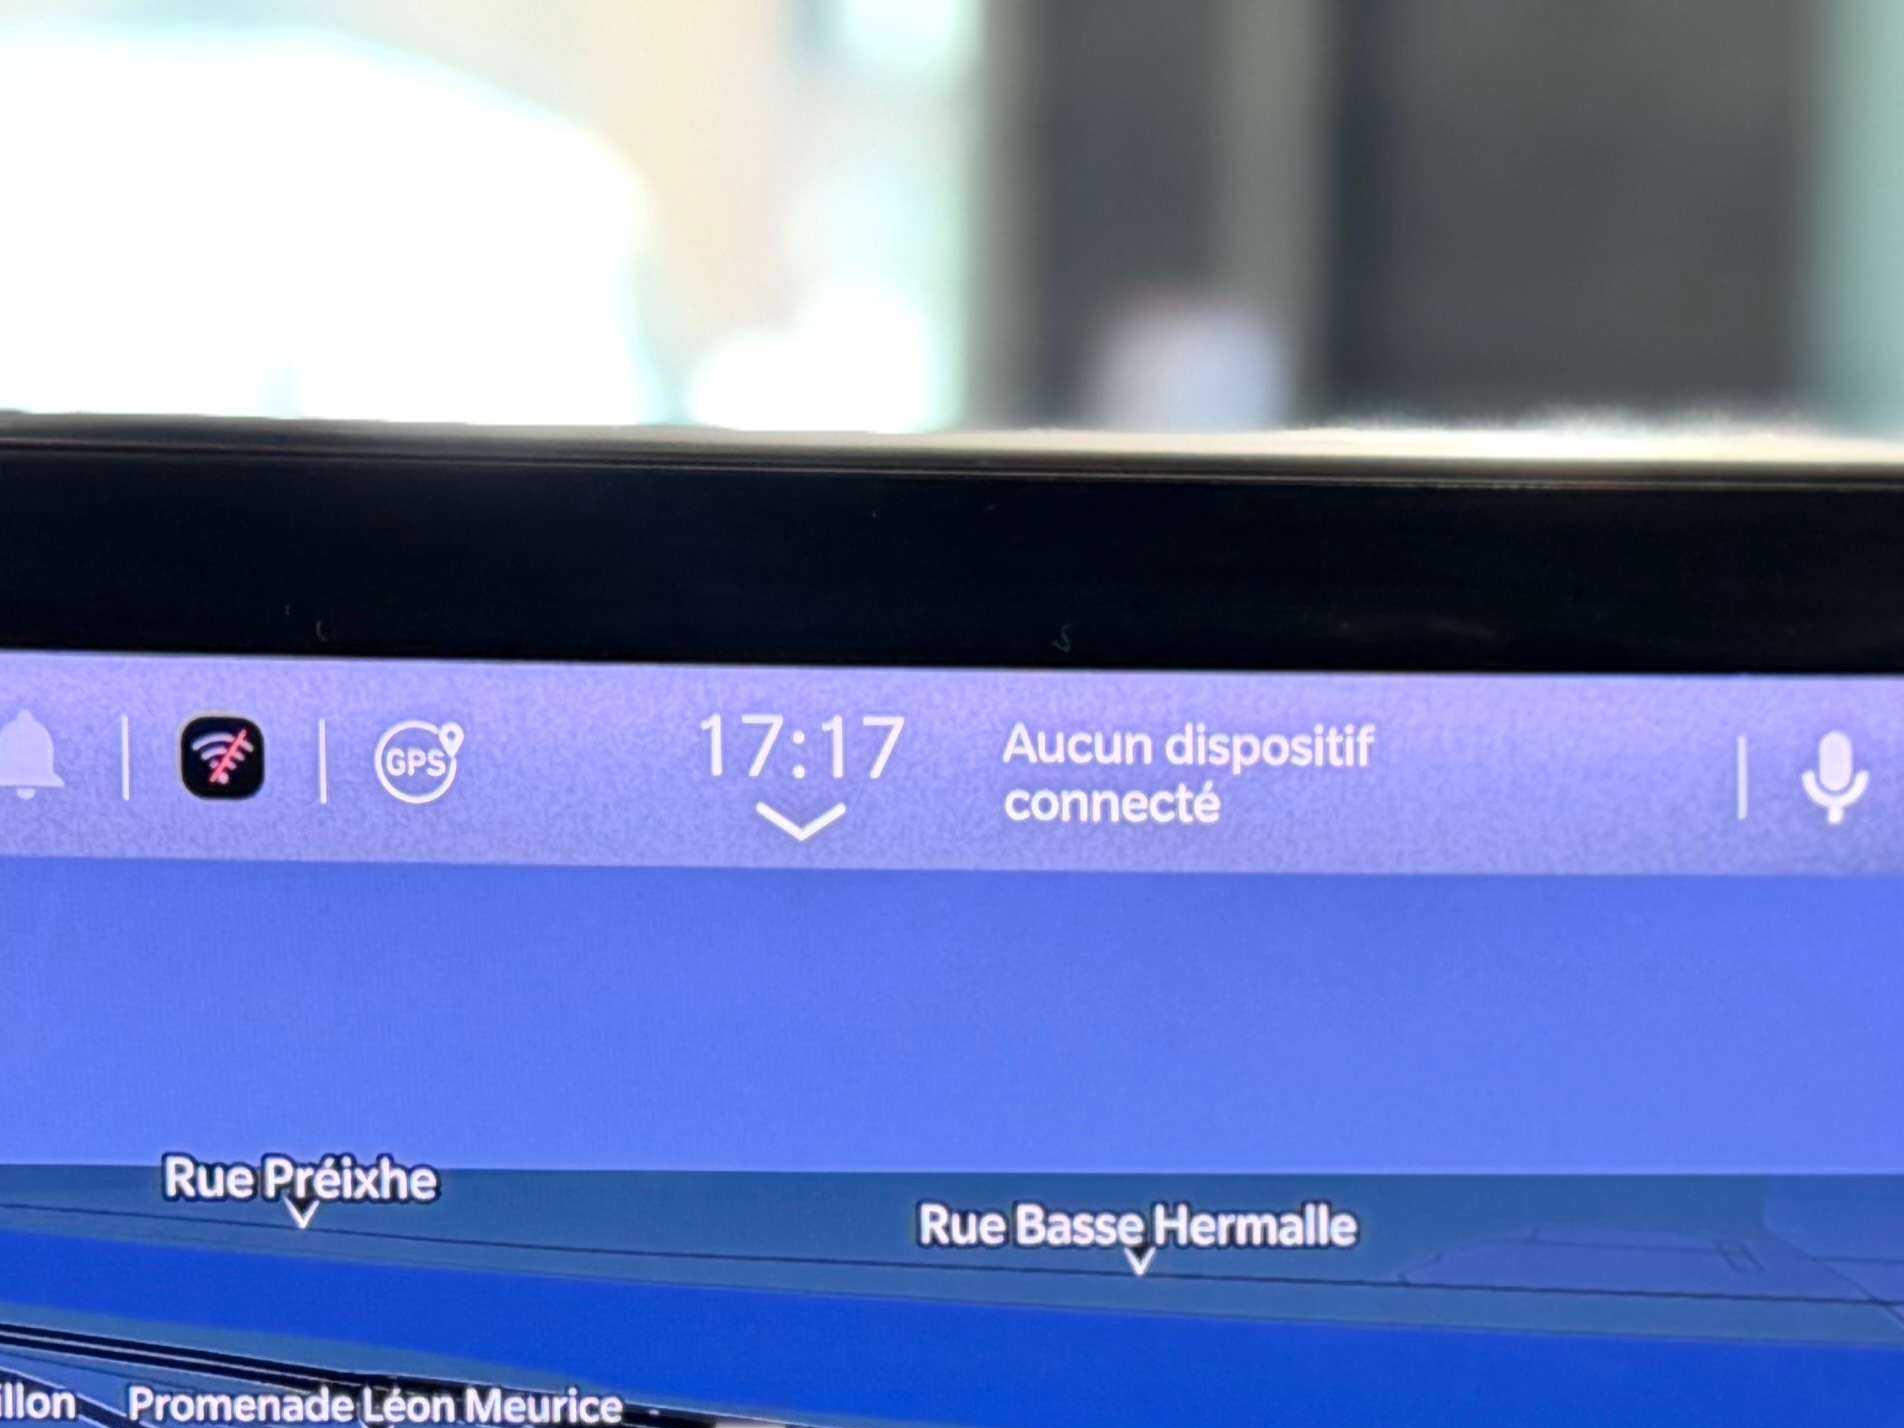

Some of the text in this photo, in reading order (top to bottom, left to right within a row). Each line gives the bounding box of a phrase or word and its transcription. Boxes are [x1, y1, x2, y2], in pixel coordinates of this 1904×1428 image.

[385, 748, 448, 777] GPS
[700, 713, 905, 779] 17:17
[1002, 720, 1378, 776] Aucun dispositif
[1004, 780, 1222, 824] connecté
[164, 1153, 439, 1202] Rue Préixhe
[918, 1205, 1360, 1248] Rue Basse Hermalle
[128, 1386, 623, 1426] Promenade Léon Meurice
